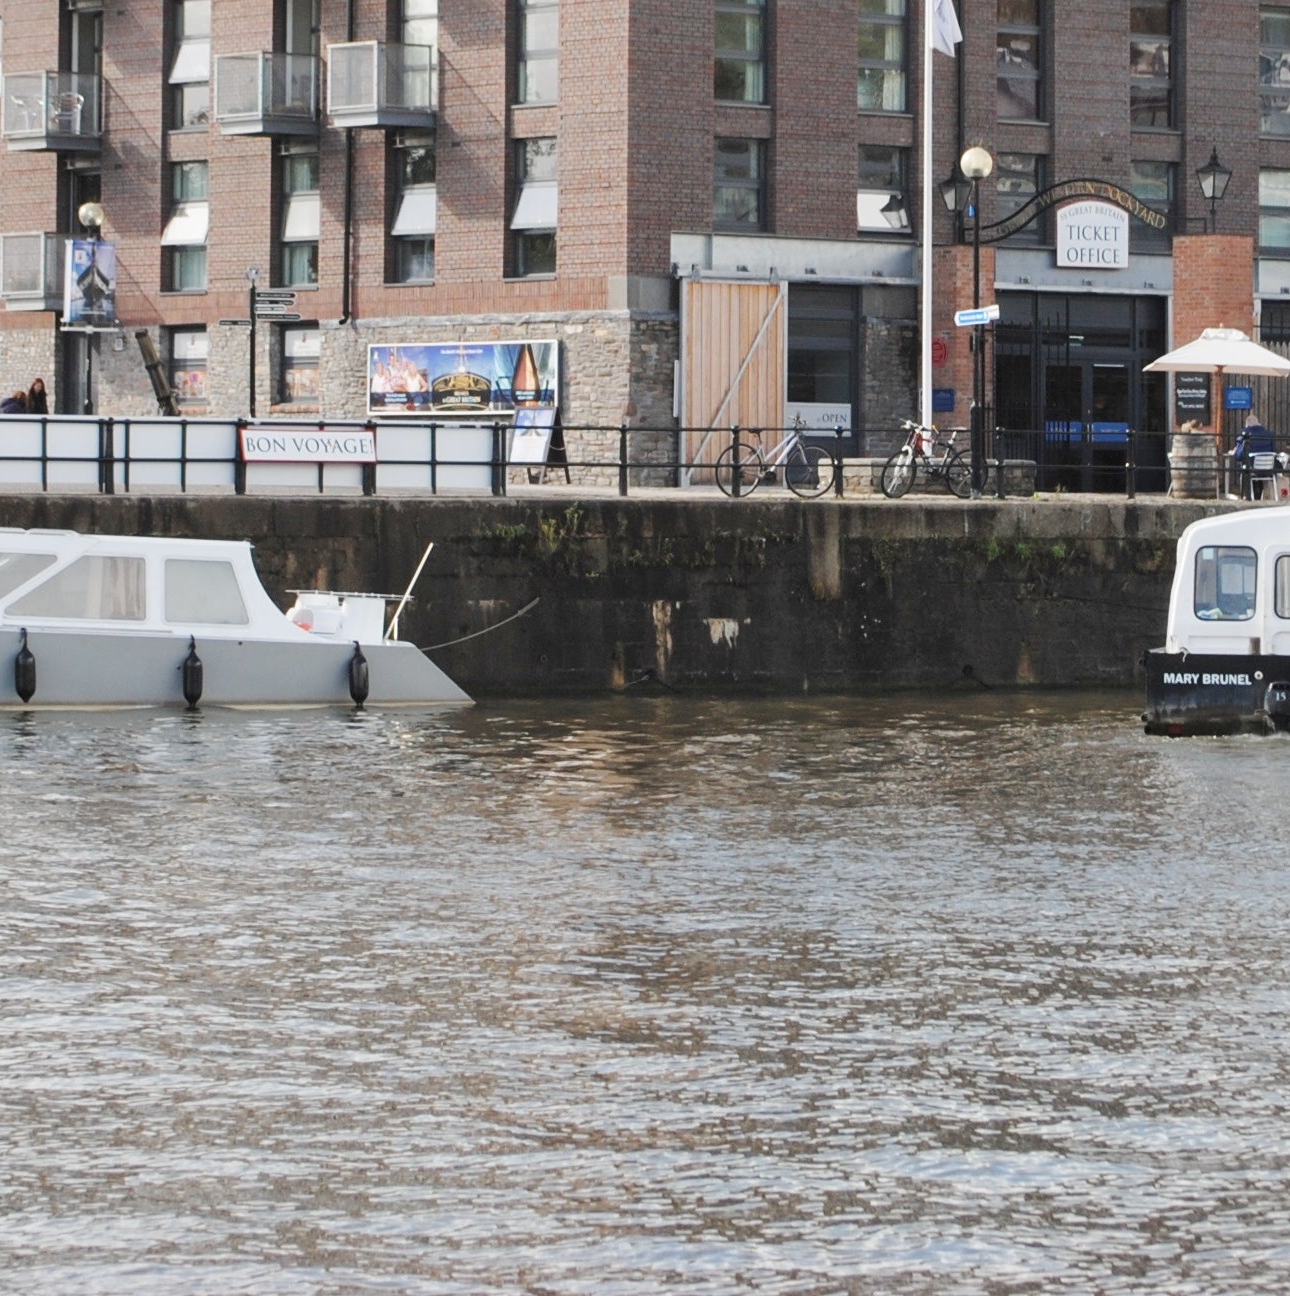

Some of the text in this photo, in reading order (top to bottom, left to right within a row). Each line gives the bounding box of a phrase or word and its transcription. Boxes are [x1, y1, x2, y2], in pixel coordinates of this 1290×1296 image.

[1066, 225, 1120, 242] TICKET
[1066, 247, 1120, 264] OFFICE
[822, 413, 847, 423] OPEN
[246, 437, 374, 454] BON VOYAGE!
[1163, 672, 1252, 685] MARY BRUNEL
